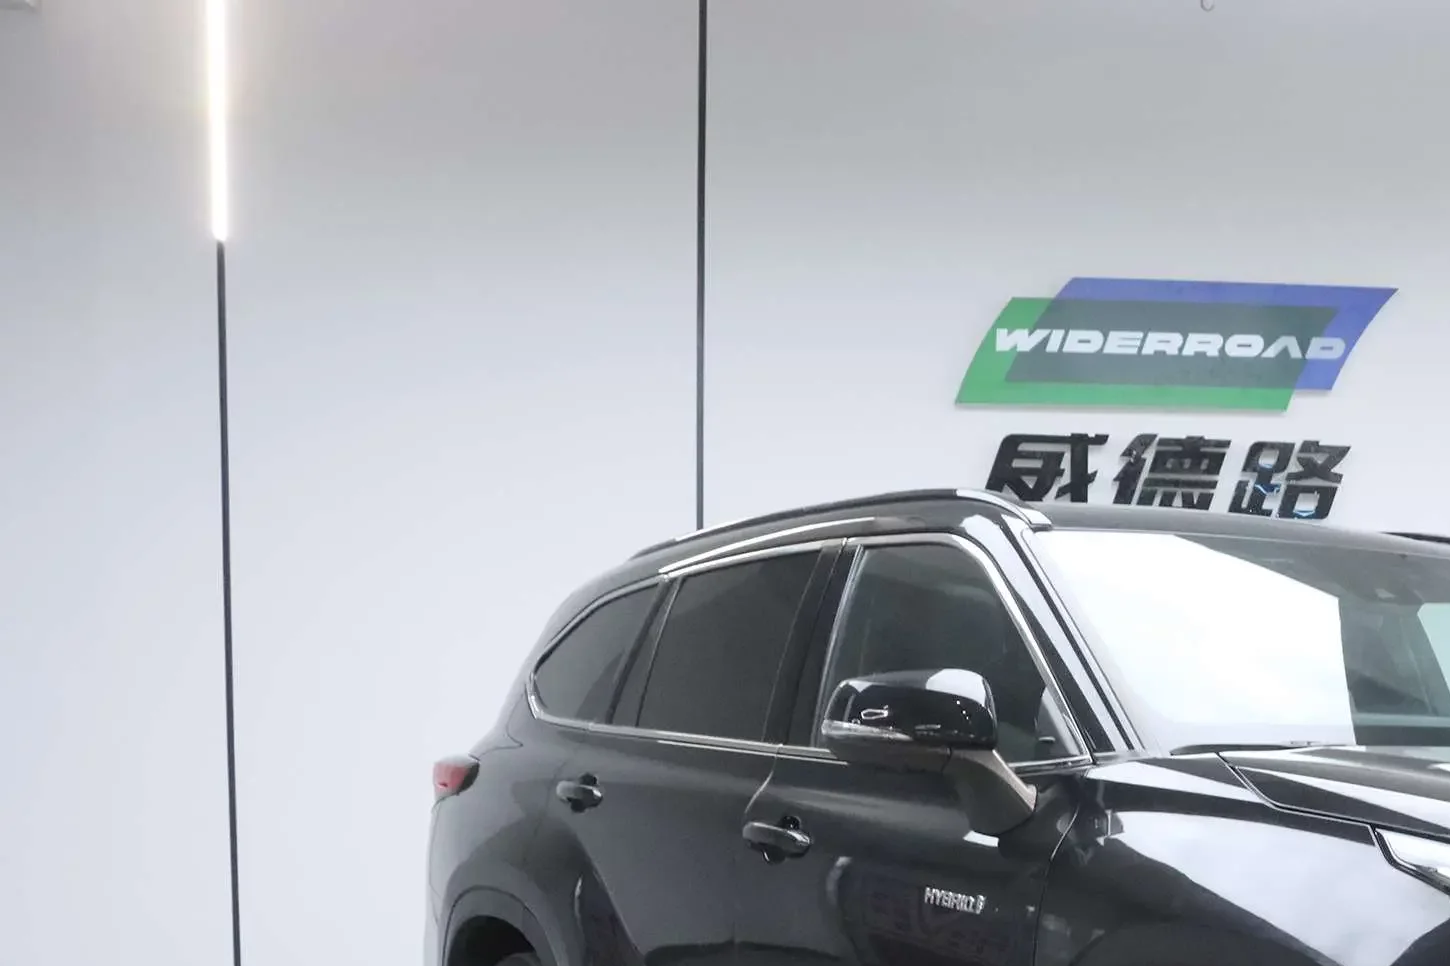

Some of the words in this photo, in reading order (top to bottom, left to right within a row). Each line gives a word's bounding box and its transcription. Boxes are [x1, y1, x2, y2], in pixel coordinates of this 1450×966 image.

[995, 328, 1347, 360] WIDERROAD
[986, 432, 1351, 520] 威德路
